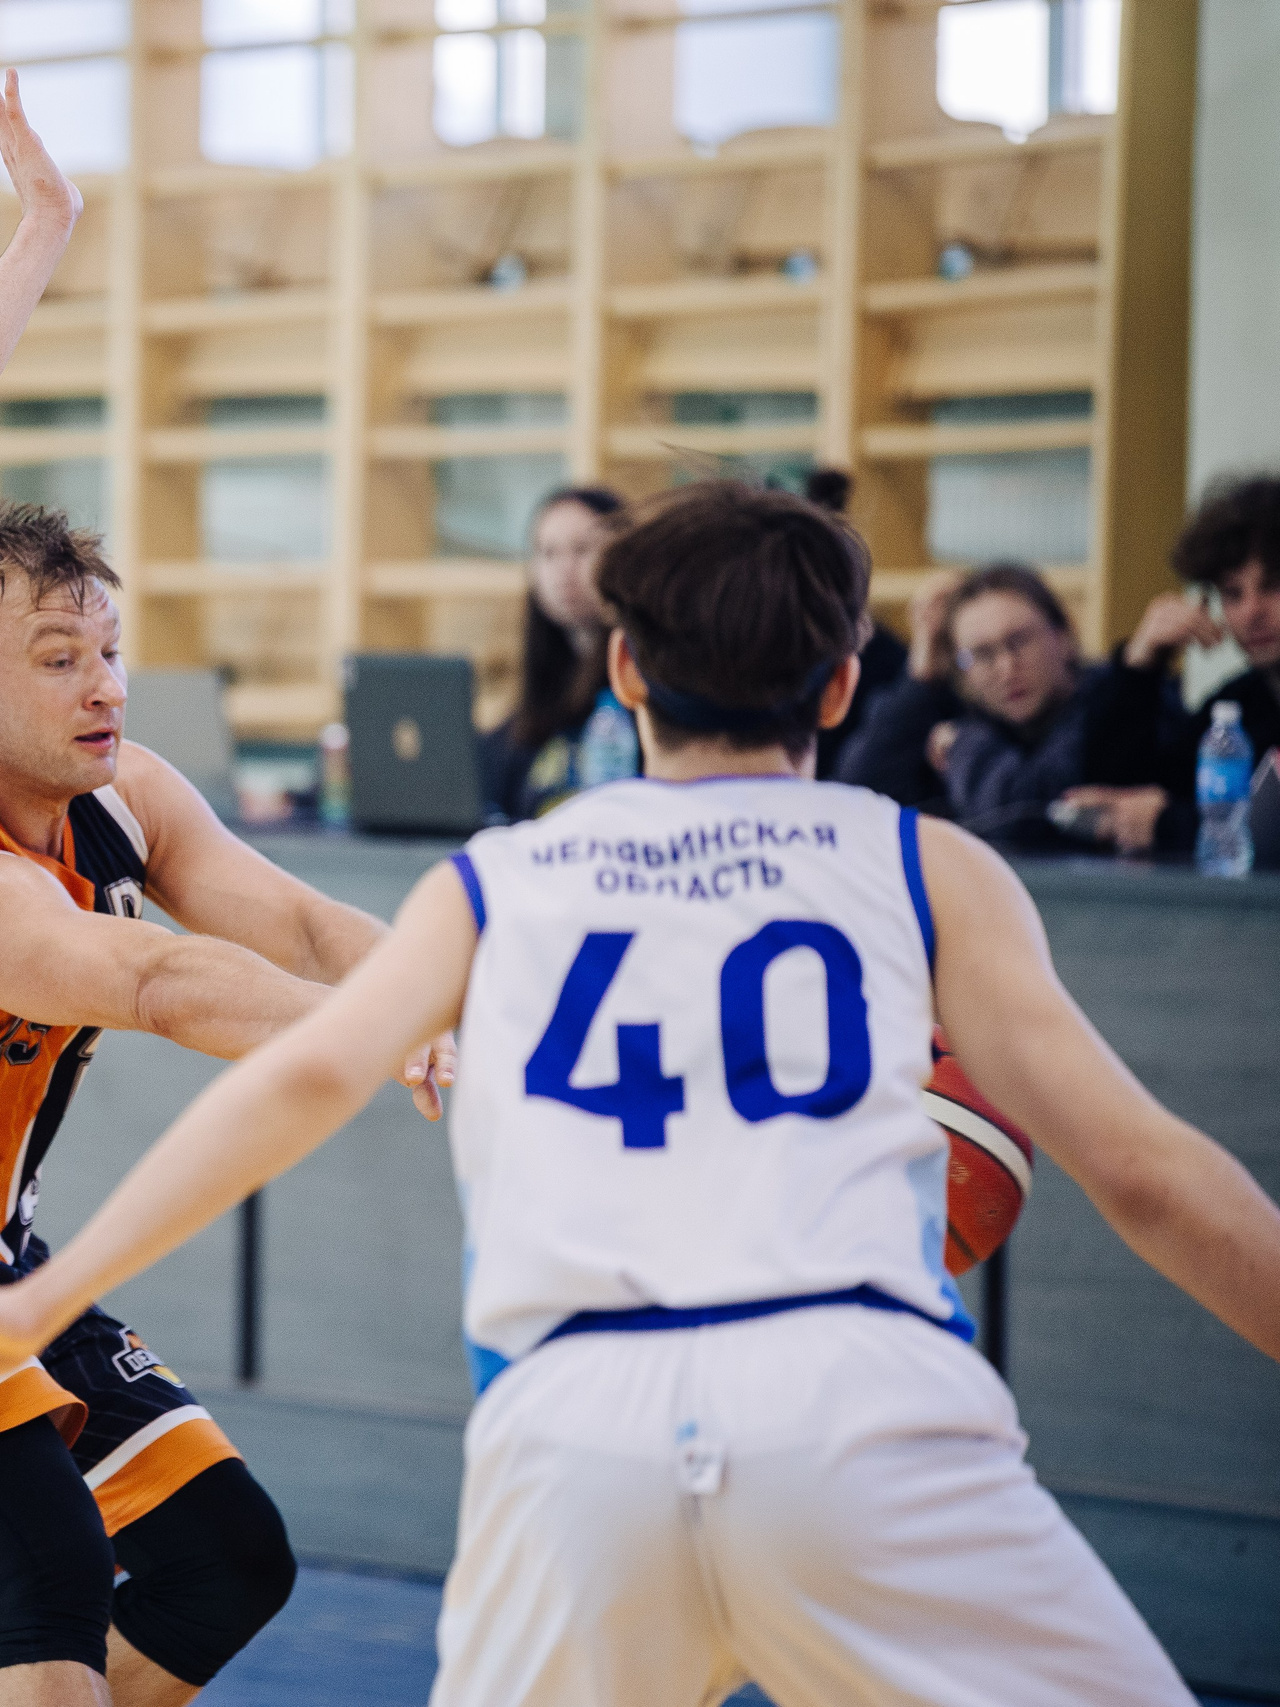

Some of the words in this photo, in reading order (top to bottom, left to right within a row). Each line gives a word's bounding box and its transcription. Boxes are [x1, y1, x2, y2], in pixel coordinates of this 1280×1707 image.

[531, 819, 837, 867] ЧЕЛЯБИНСКАЯ
[595, 859, 783, 901] ОБЛАСТЬ
[524, 919, 872, 1149] 40
